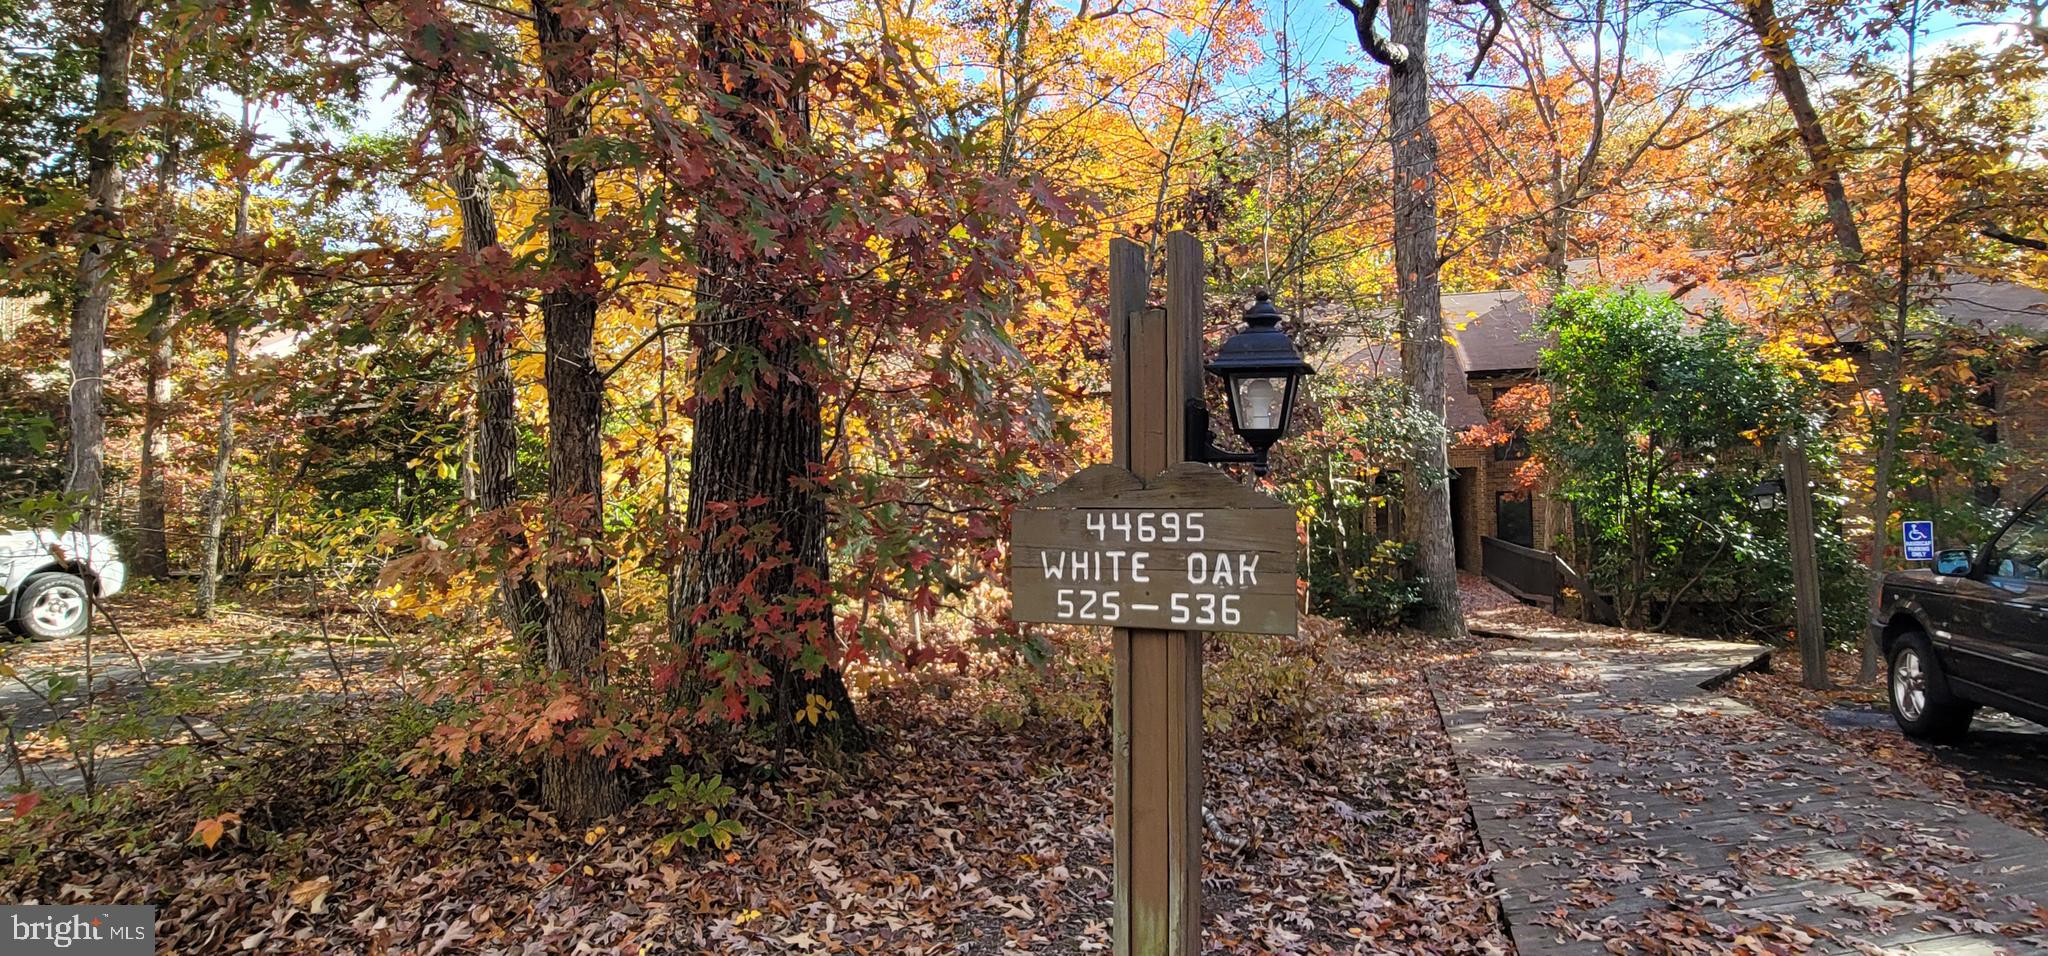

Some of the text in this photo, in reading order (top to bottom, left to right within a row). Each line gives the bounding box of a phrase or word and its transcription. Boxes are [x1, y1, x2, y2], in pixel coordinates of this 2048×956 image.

[1086, 512, 1205, 542] 44695
[1040, 551, 1259, 584] WHITE OAK
